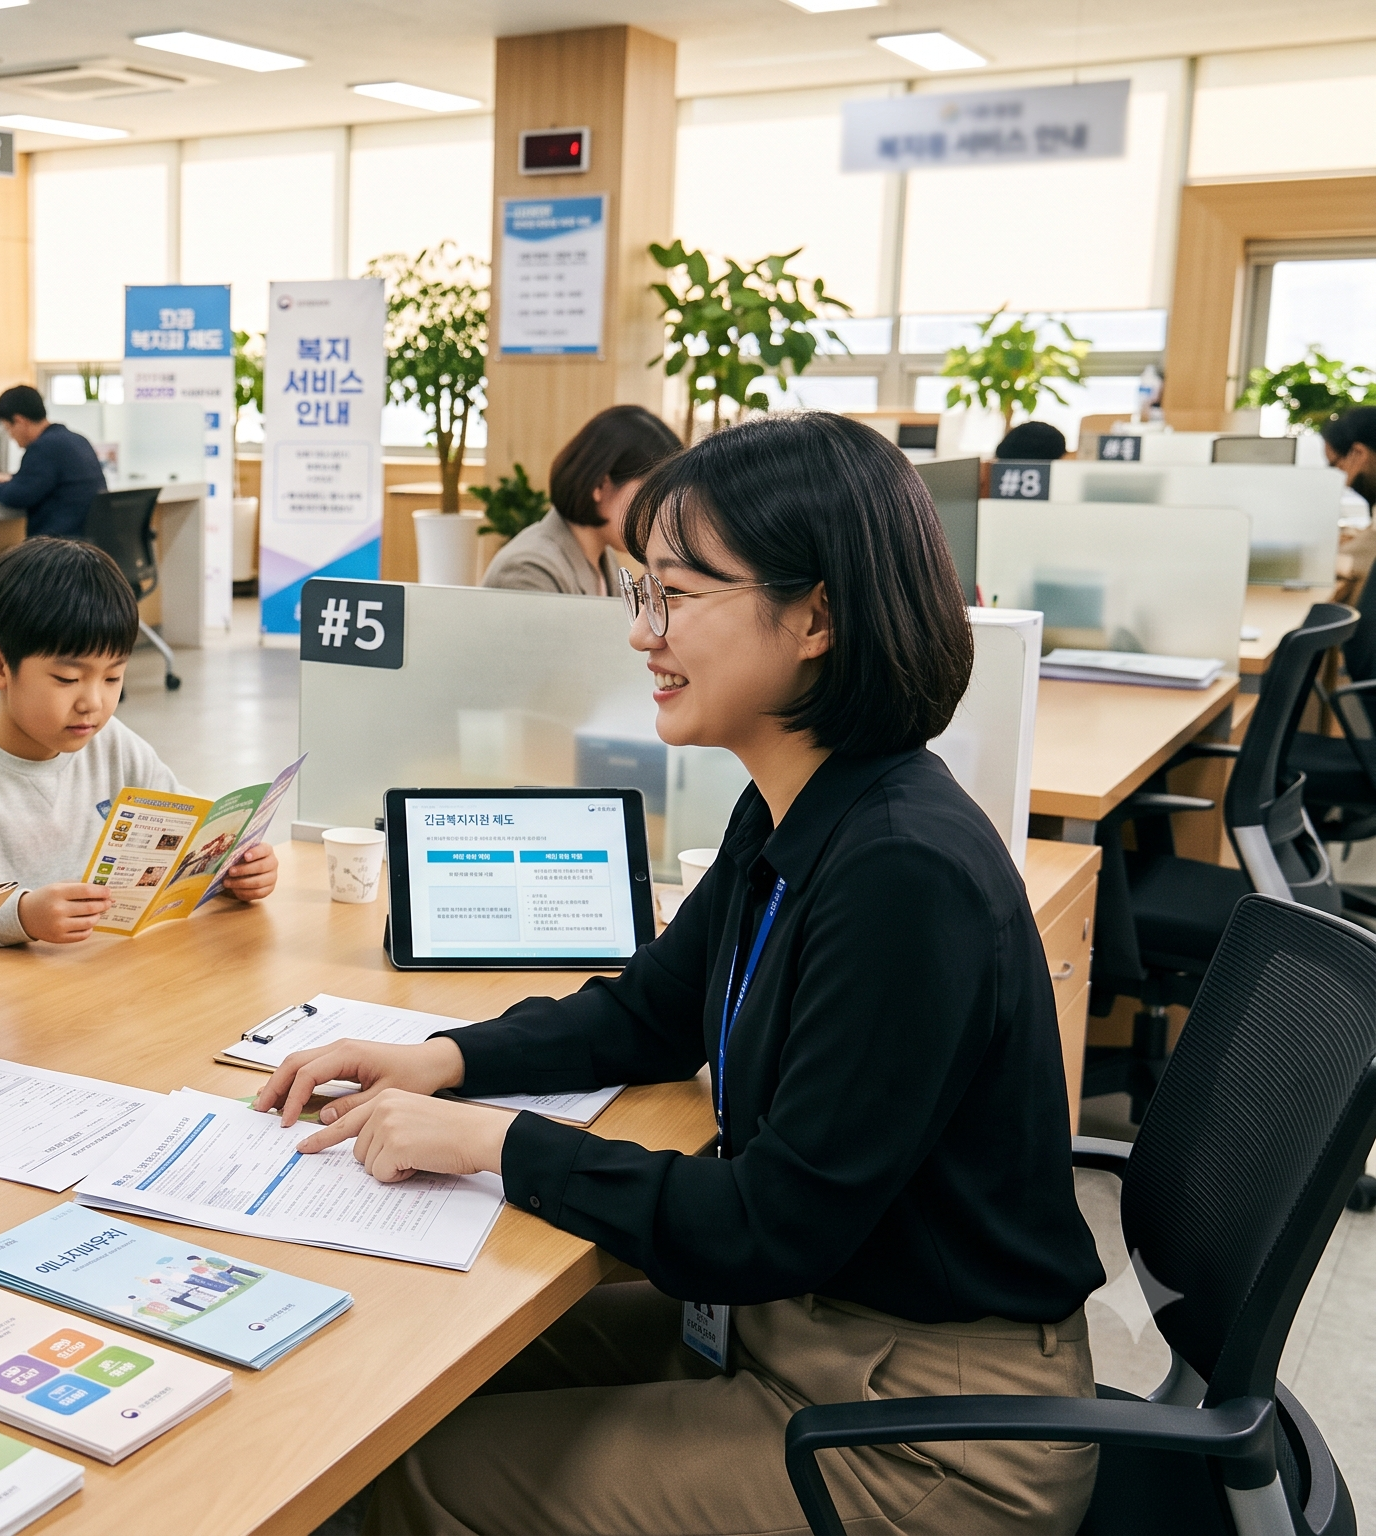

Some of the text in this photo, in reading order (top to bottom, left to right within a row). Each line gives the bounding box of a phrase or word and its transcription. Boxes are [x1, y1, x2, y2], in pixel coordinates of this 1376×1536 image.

[297, 337, 351, 363] 복지
[283, 368, 364, 396] 서비스
[296, 400, 350, 427] 안내
[998, 469, 1041, 497] #8
[317, 598, 386, 651] #5
[492, 813, 515, 826] 제도
